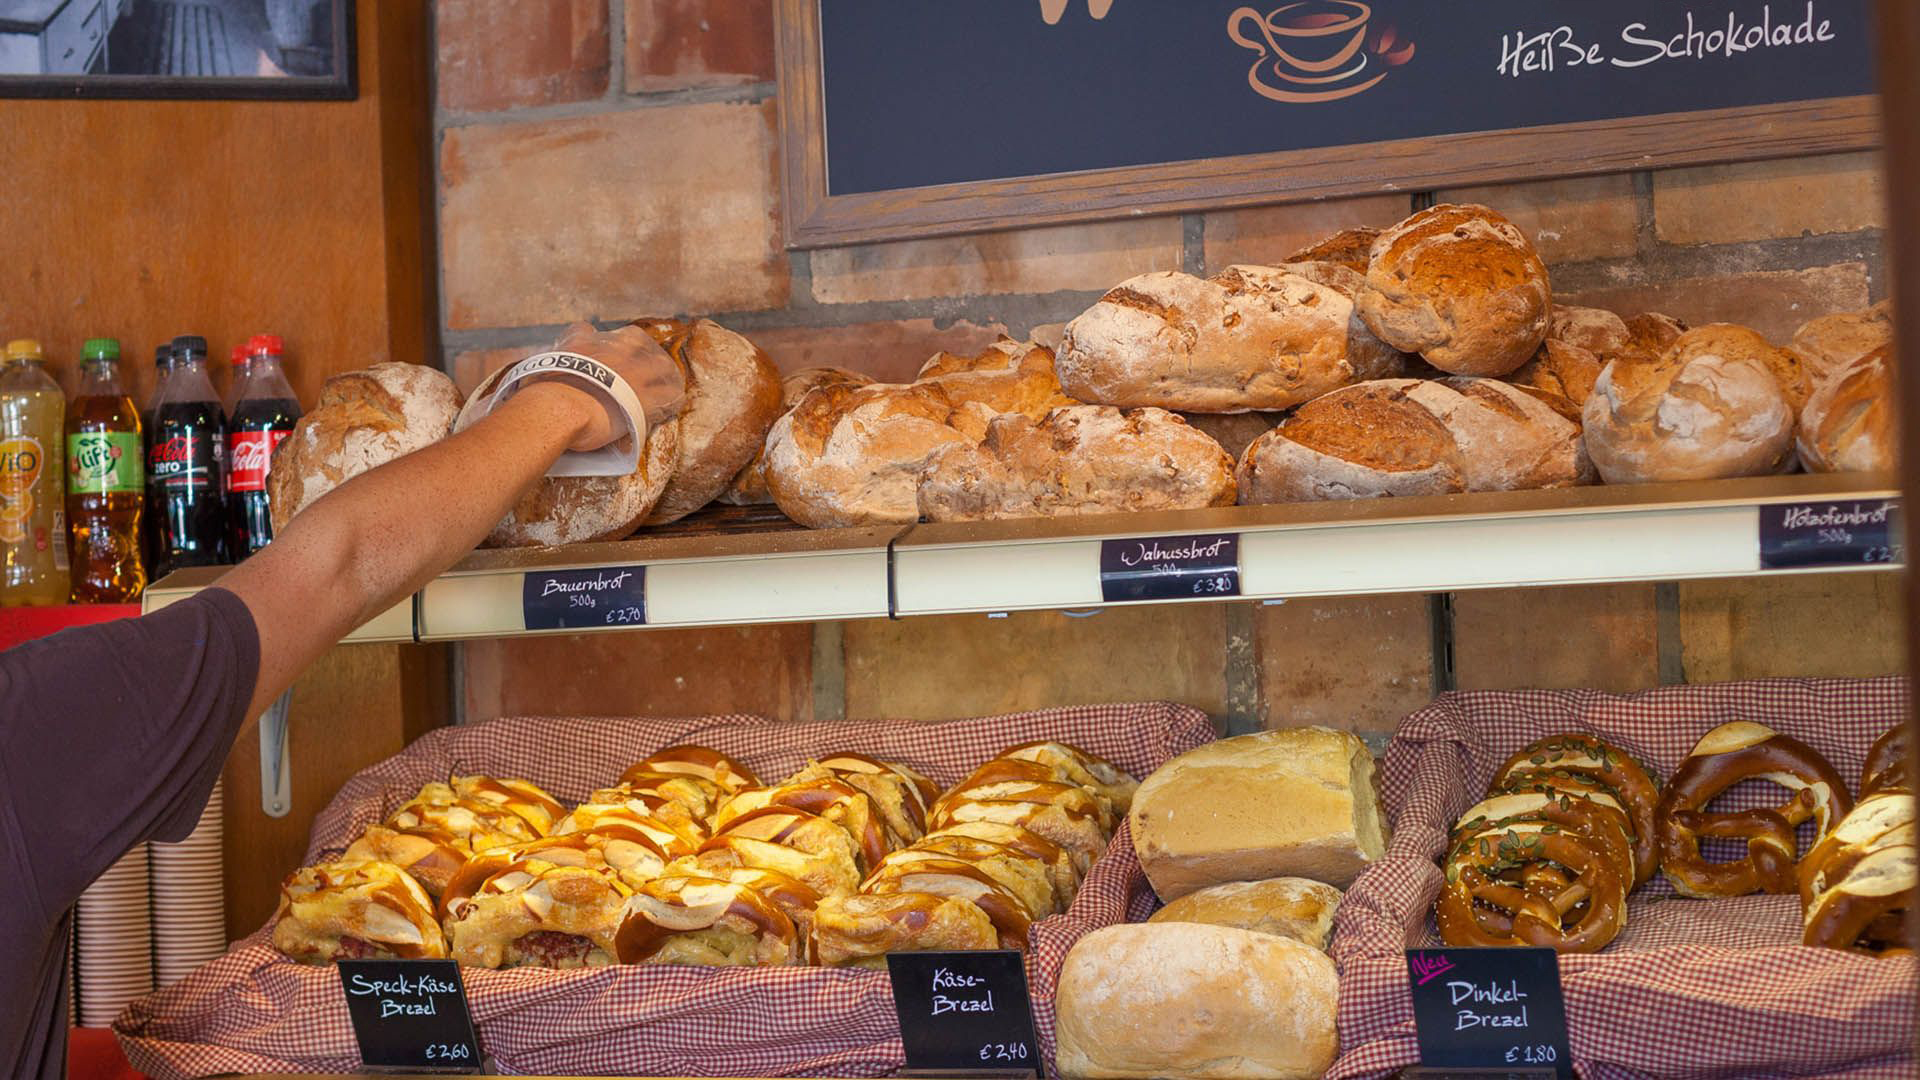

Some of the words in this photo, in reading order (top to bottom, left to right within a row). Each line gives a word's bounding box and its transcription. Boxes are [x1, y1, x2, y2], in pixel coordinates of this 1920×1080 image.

[1497, 26, 1604, 77] Heiße
[1611, 1, 1836, 67] Schokolade
[1121, 538, 1230, 566] Walnussbrot
[541, 571, 632, 596] Bauernbrot
[569, 594, 596, 608] 500g
[1411, 951, 1450, 976] Neu
[350, 974, 457, 997] Speck-Käse
[932, 968, 986, 992] Käse-
[931, 990, 994, 1016] Brezel
[1446, 980, 1528, 1006] Dinkel-
[381, 996, 437, 1018] Brezel
[1454, 1005, 1529, 1030] Brezel
